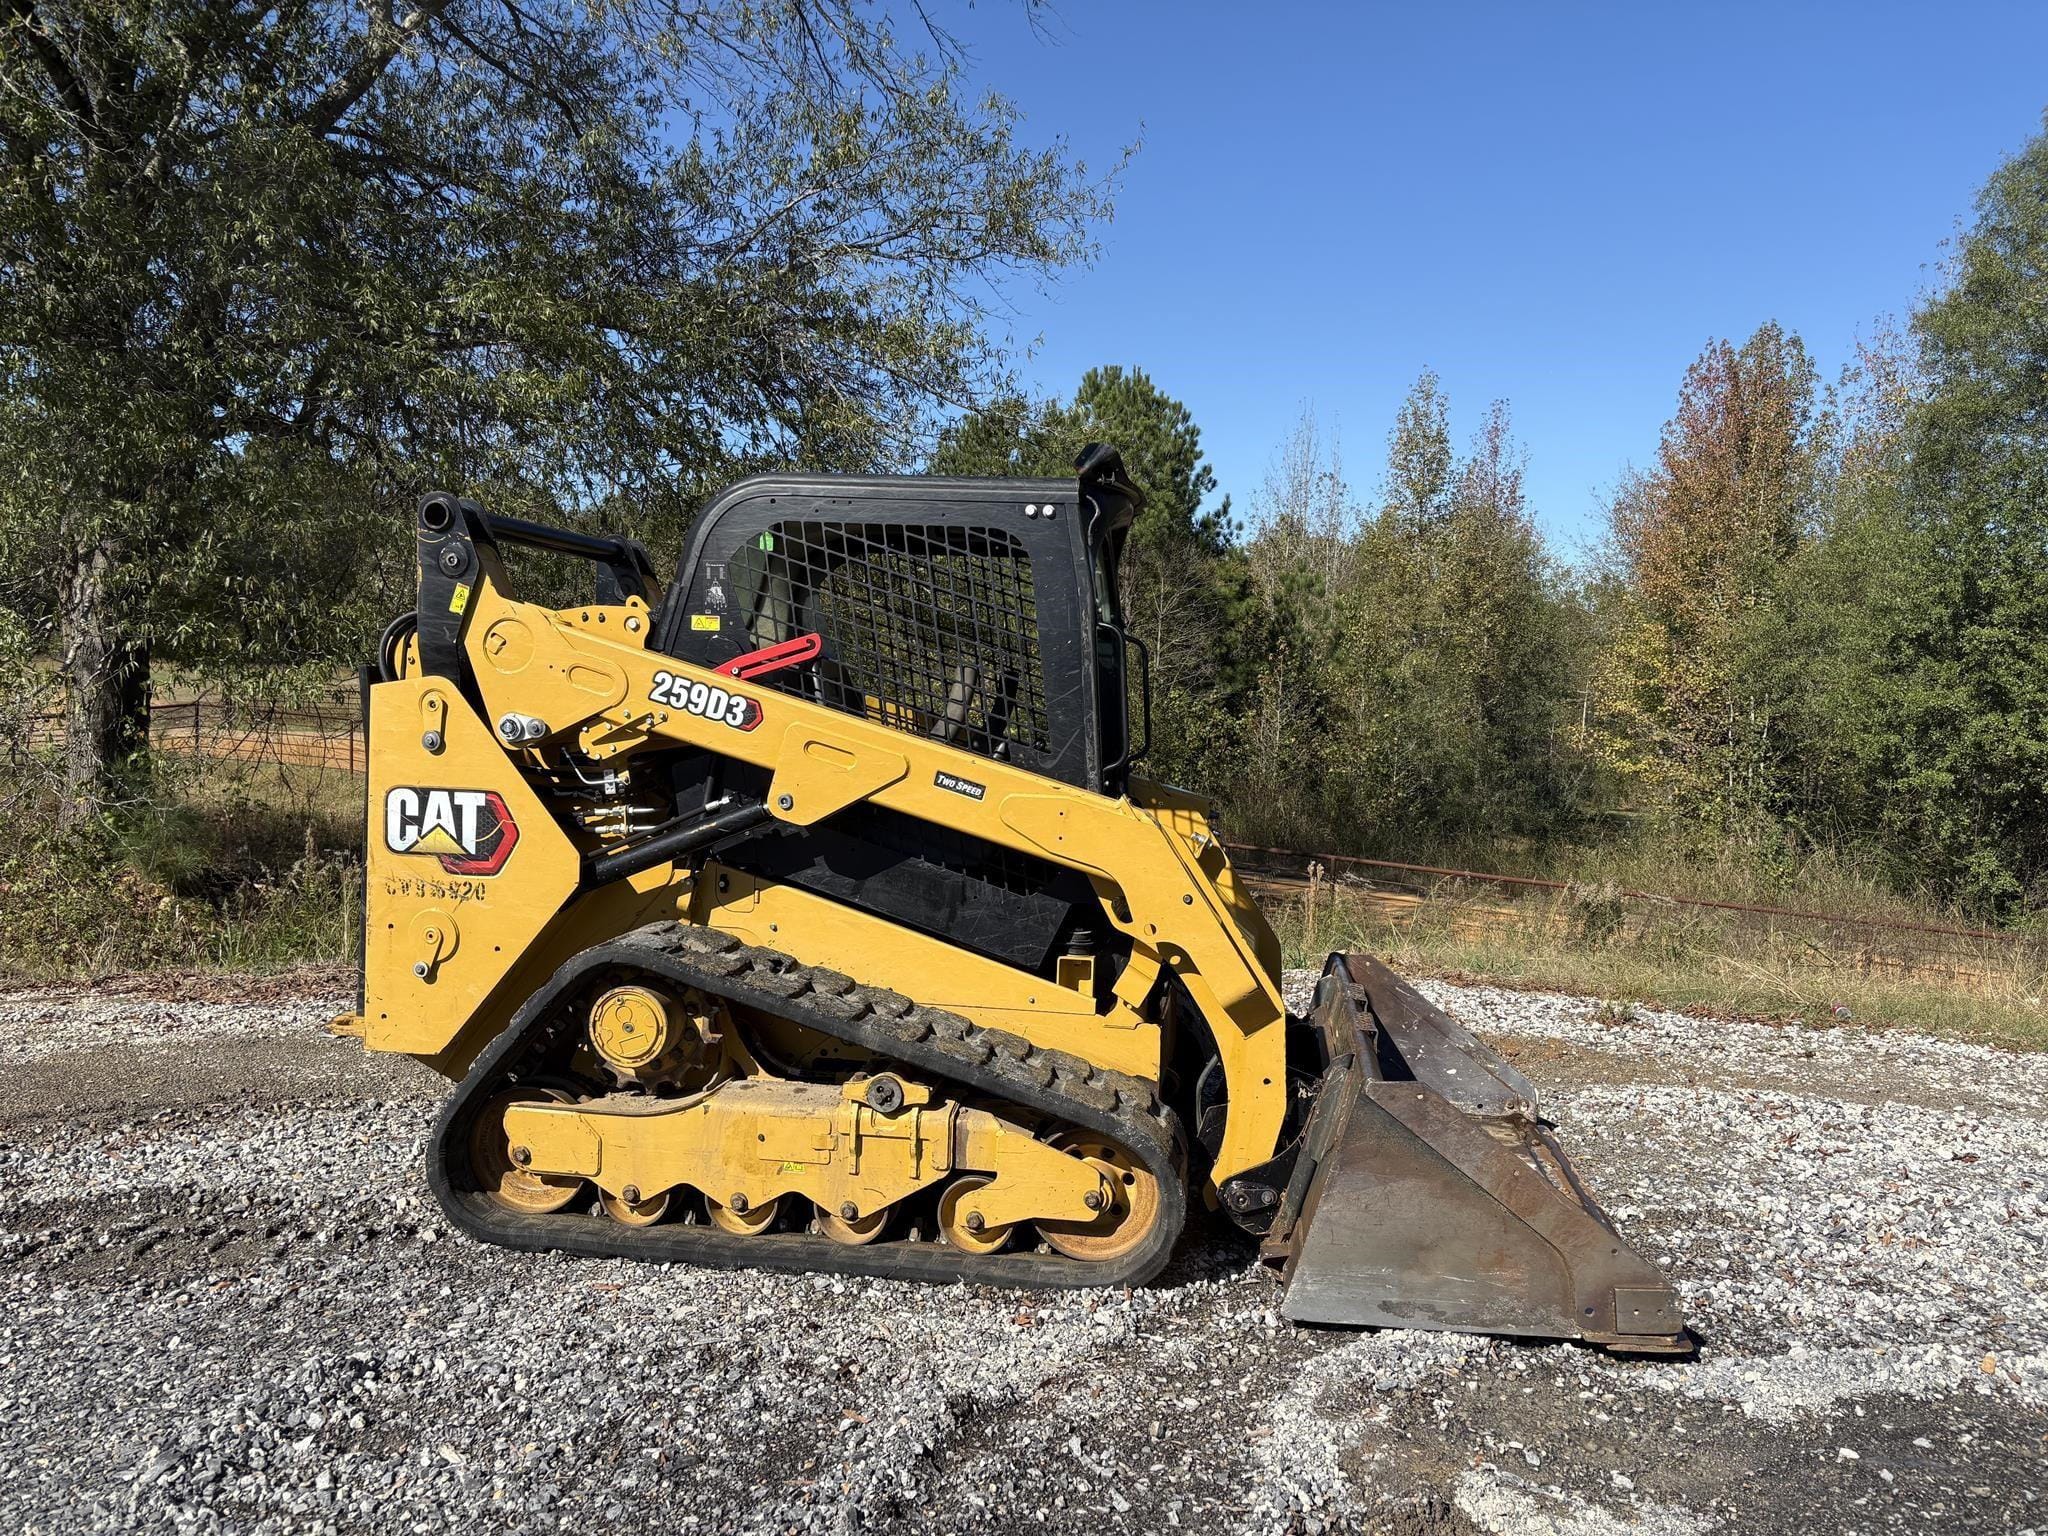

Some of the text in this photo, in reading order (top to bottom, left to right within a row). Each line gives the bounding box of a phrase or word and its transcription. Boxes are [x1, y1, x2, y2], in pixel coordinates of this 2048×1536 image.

[649, 671, 748, 727] 259D3
[937, 774, 982, 796] TWO SPEED
[387, 787, 486, 855] CAT
